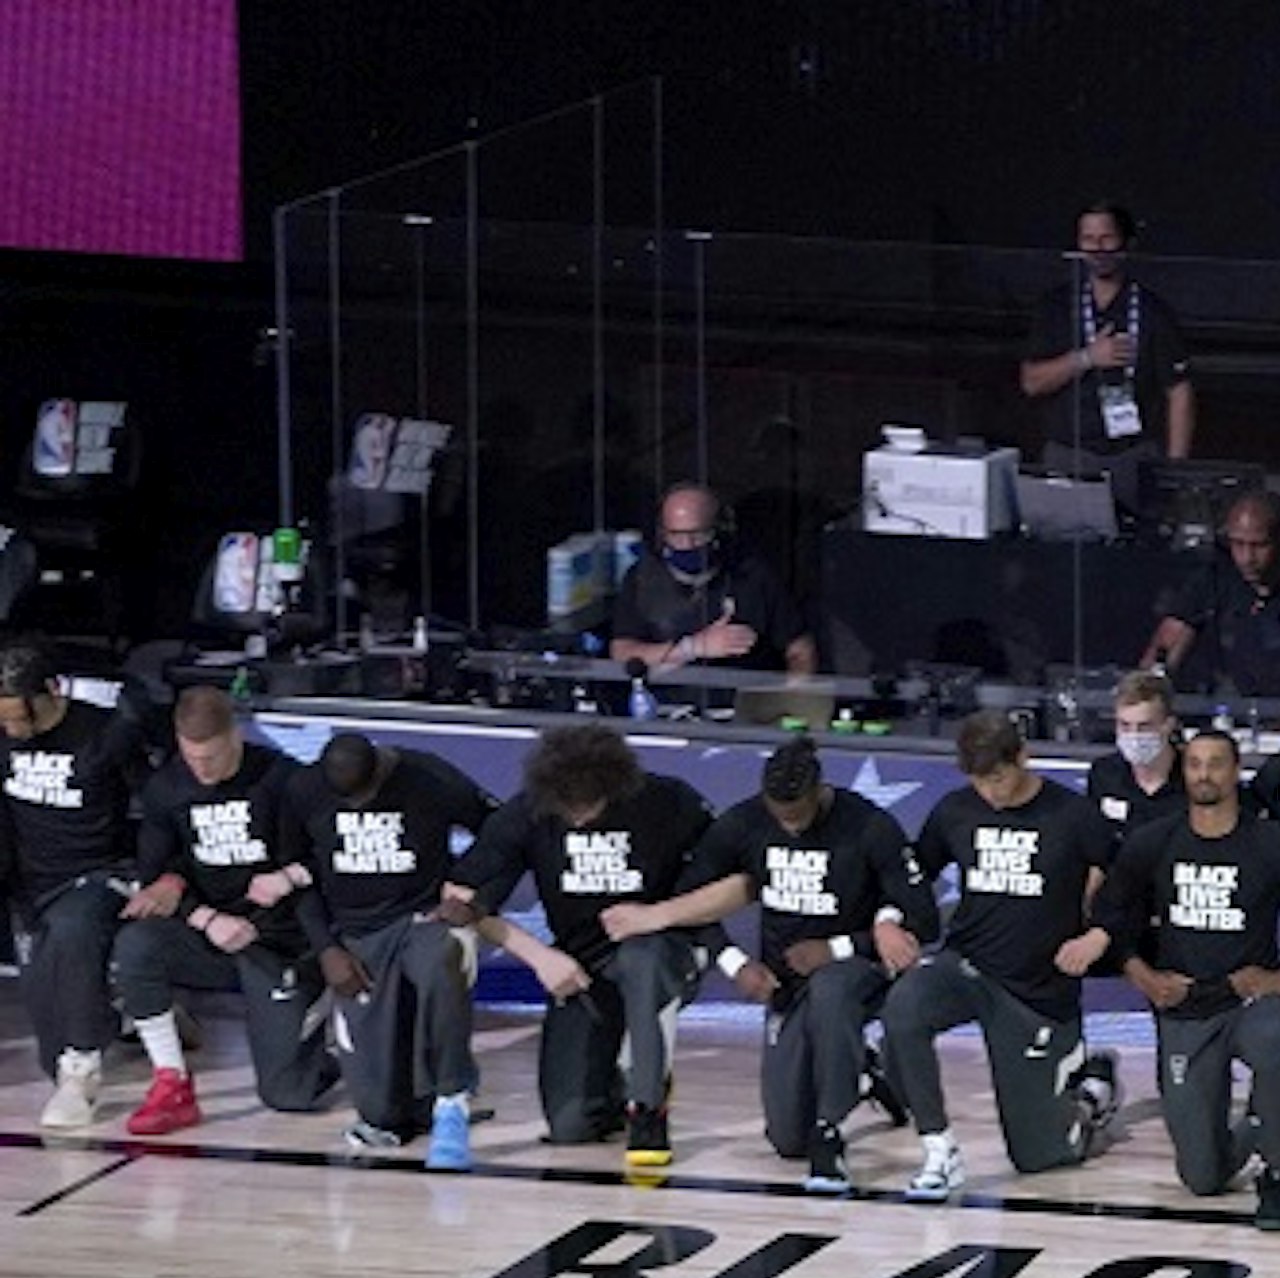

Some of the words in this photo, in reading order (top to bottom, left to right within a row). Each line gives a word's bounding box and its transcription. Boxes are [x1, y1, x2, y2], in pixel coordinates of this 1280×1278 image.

[190, 801, 252, 828] BLACK
[336, 812, 405, 836] BLACK
[343, 832, 401, 854] LIVES
[566, 832, 632, 855] BLACK
[974, 827, 1039, 854] BLACK
[332, 850, 417, 873] MATTER
[572, 853, 628, 875] LIVES
[765, 846, 828, 876] BLACK
[978, 850, 1032, 874] LIVES
[561, 871, 643, 894] MATTER
[770, 869, 824, 894] LIVES
[966, 869, 1045, 897] MATTER
[1173, 862, 1239, 890] BLACK
[762, 886, 839, 916] MATTER
[1176, 885, 1231, 909] LIVES
[1169, 904, 1247, 931] MATTER
